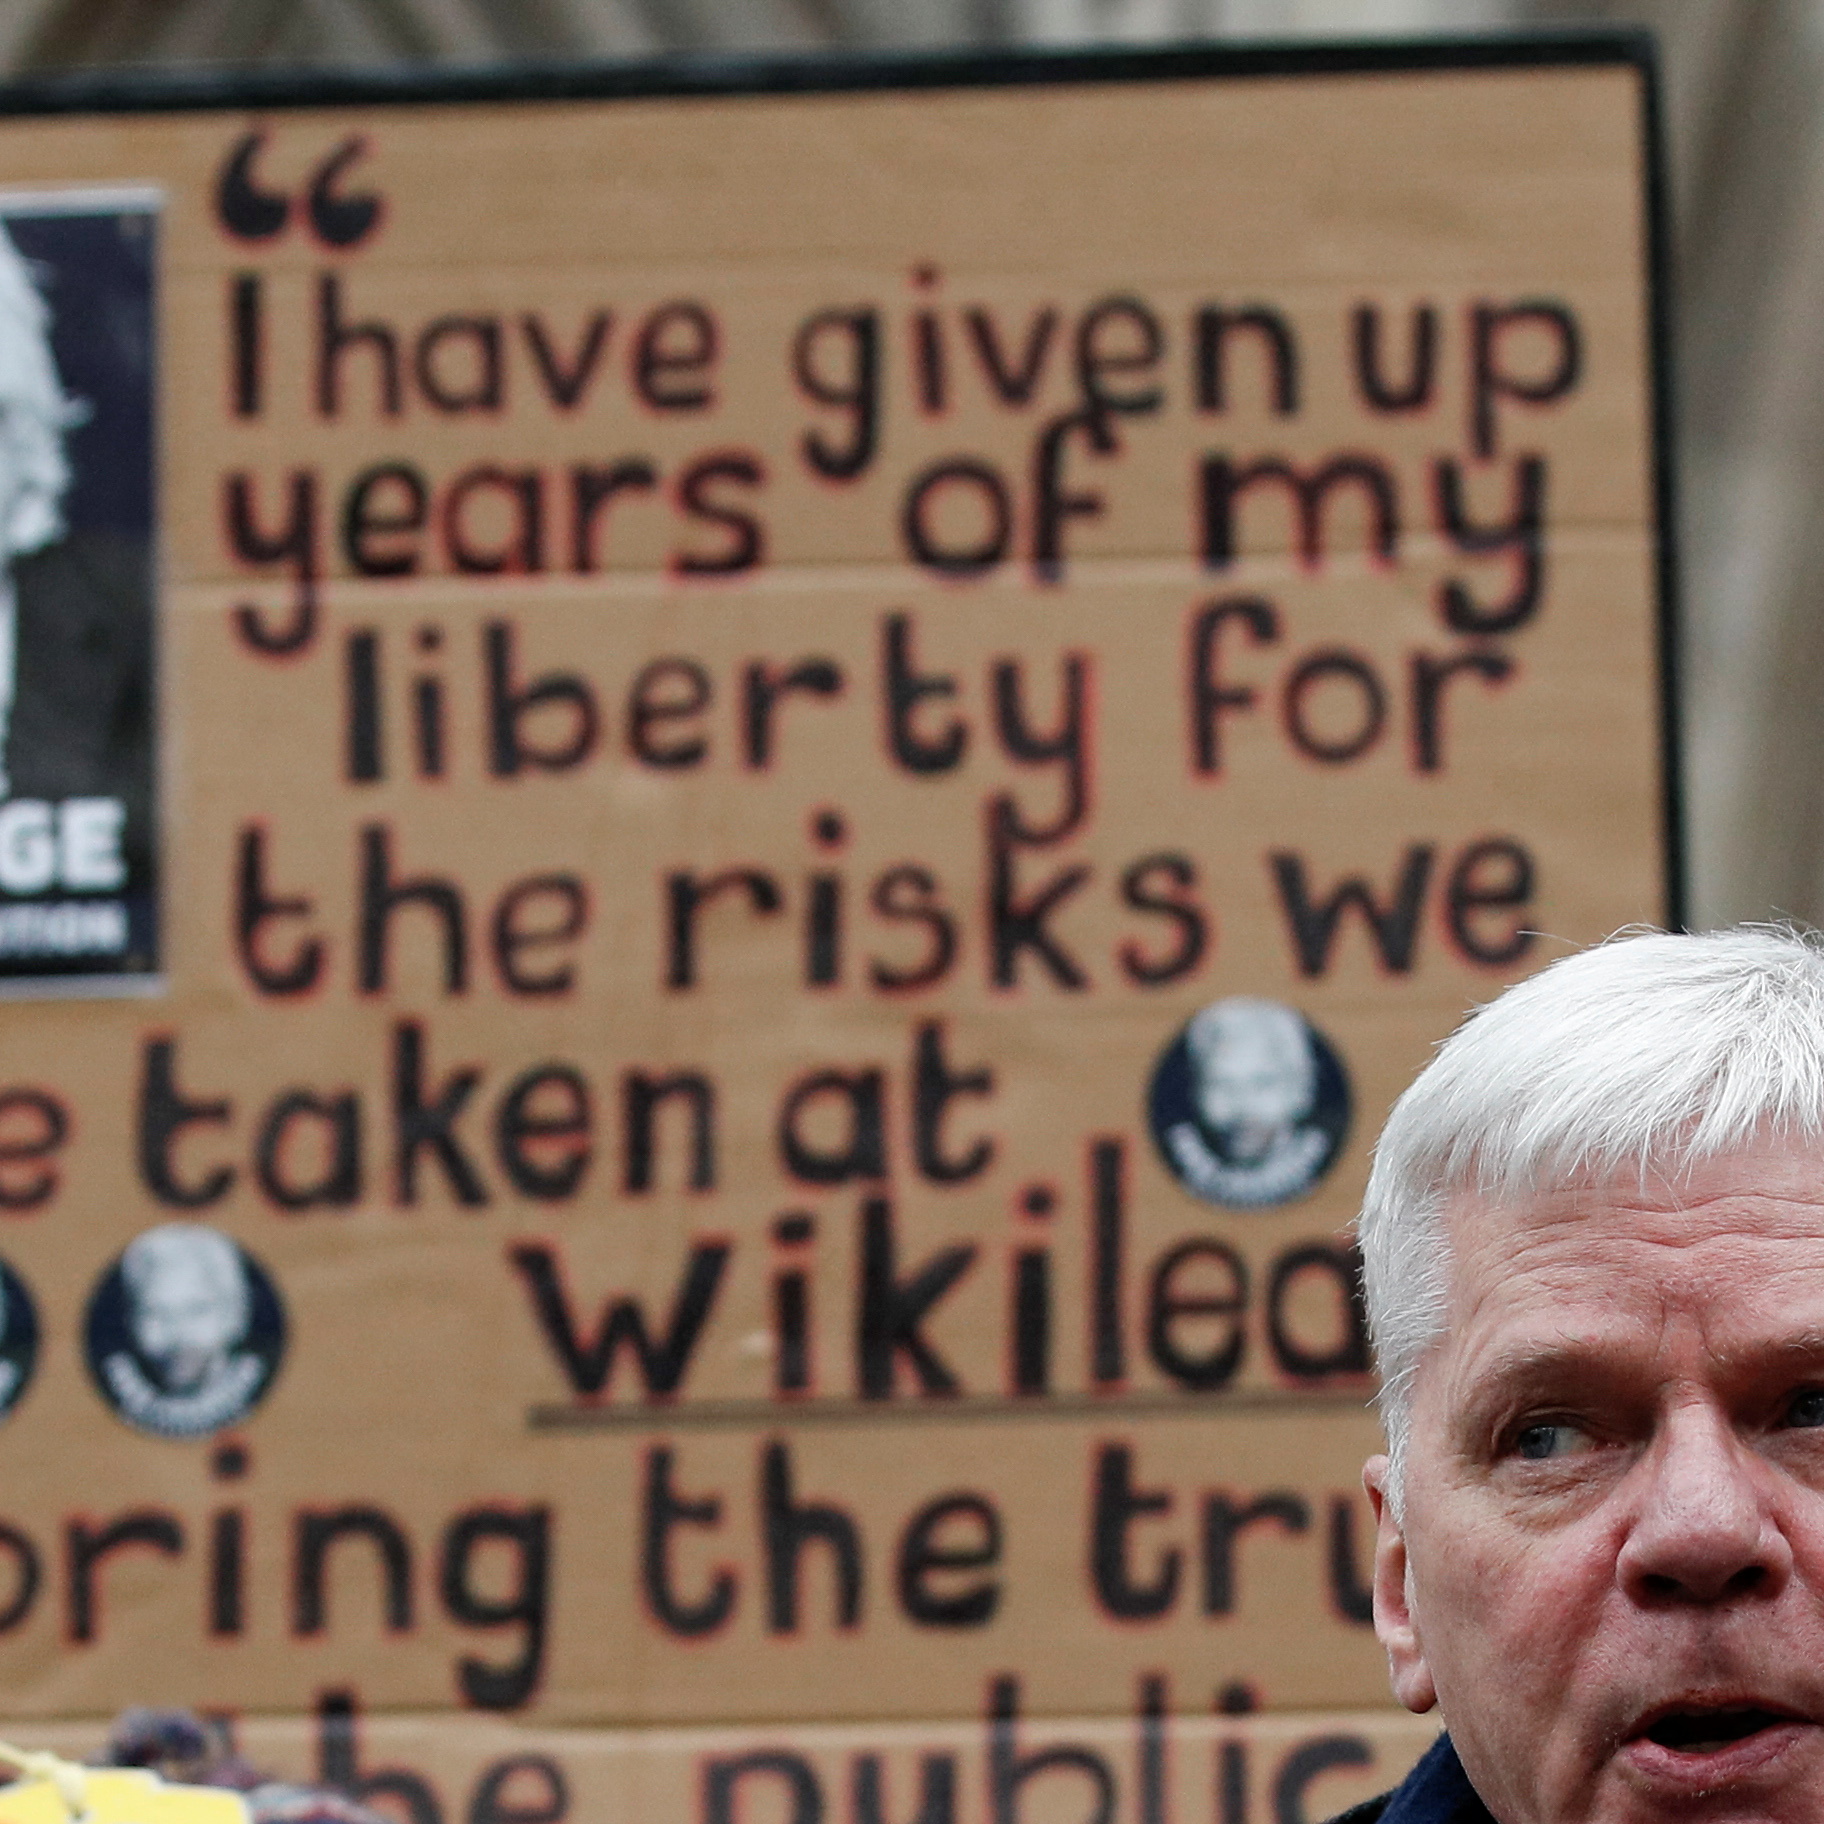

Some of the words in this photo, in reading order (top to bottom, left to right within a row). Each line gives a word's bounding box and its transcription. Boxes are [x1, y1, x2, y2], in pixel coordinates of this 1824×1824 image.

[228, 270, 264, 421] I
[315, 270, 722, 421] have
[791, 264, 1301, 481] given
[1353, 298, 1584, 457] up
[224, 451, 767, 658] years
[902, 403, 1121, 583] of
[1196, 447, 1550, 640] my
[344, 613, 1092, 848] liberty
[1190, 598, 1516, 780] for
[234, 818, 589, 996] the
[661, 812, 1213, 993] risks
[1269, 836, 1540, 977] we
[140, 1018, 718, 1213] taken
[779, 1018, 999, 1187] at
[646, 1438, 1002, 1634] the
